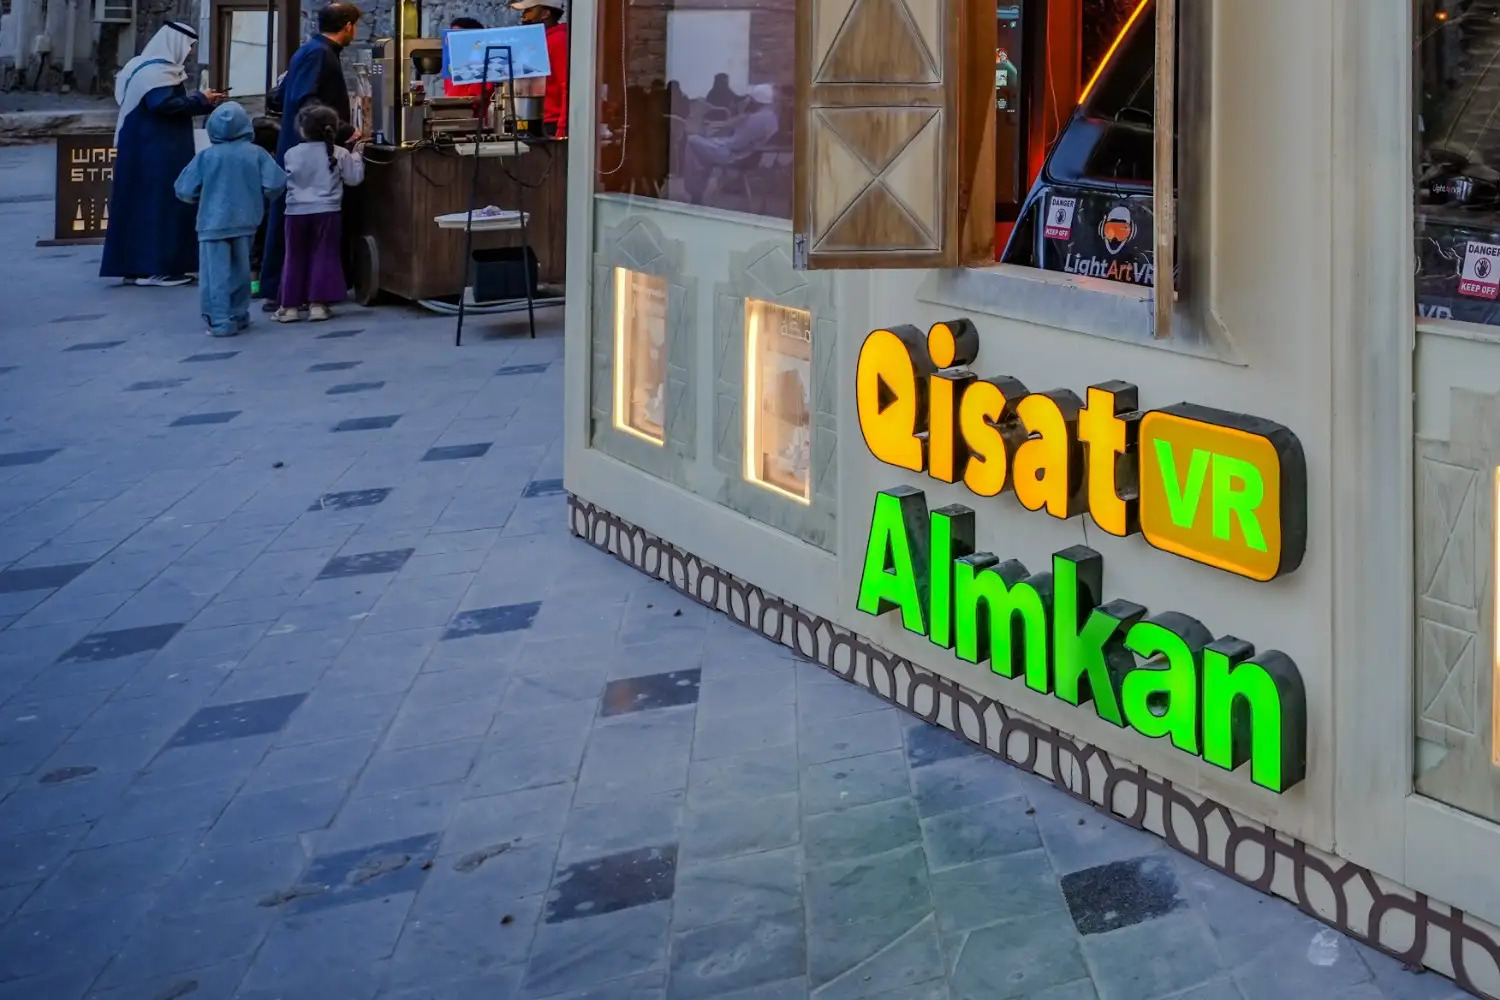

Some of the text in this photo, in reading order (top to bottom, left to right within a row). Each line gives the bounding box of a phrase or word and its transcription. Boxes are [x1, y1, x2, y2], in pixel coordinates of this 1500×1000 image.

[71, 148, 118, 164] WAF
[1051, 197, 1075, 208] DANGER
[1460, 281, 1497, 295] KEEP OFF
[856, 319, 1268, 553] Qisat VR
[856, 488, 1295, 794] Almkan
